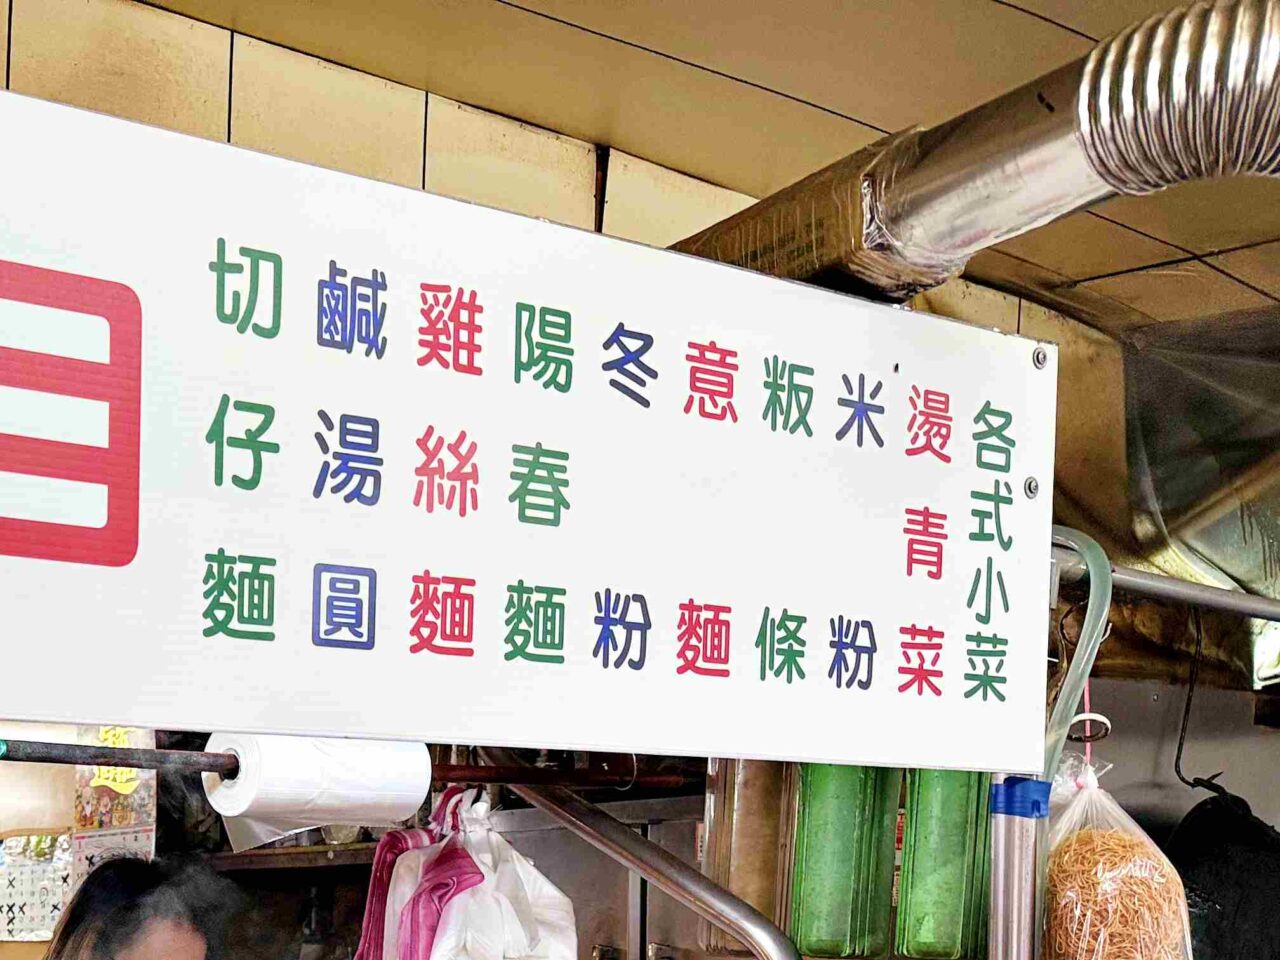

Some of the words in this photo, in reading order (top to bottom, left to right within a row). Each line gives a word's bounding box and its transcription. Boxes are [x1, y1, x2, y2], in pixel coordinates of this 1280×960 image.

[201, 237, 283, 643] 切仔麵
[311, 260, 388, 651] 鹹湯圓
[409, 282, 484, 658] 雞絲麵
[503, 302, 575, 665] 陽春麵
[593, 321, 659, 671] 冬粉
[675, 340, 739, 678] 意麵
[754, 354, 815, 684] 粄條
[828, 372, 886, 691] 米粉
[897, 384, 953, 698] 燙青菜
[963, 400, 1017, 703] 各式小菜
